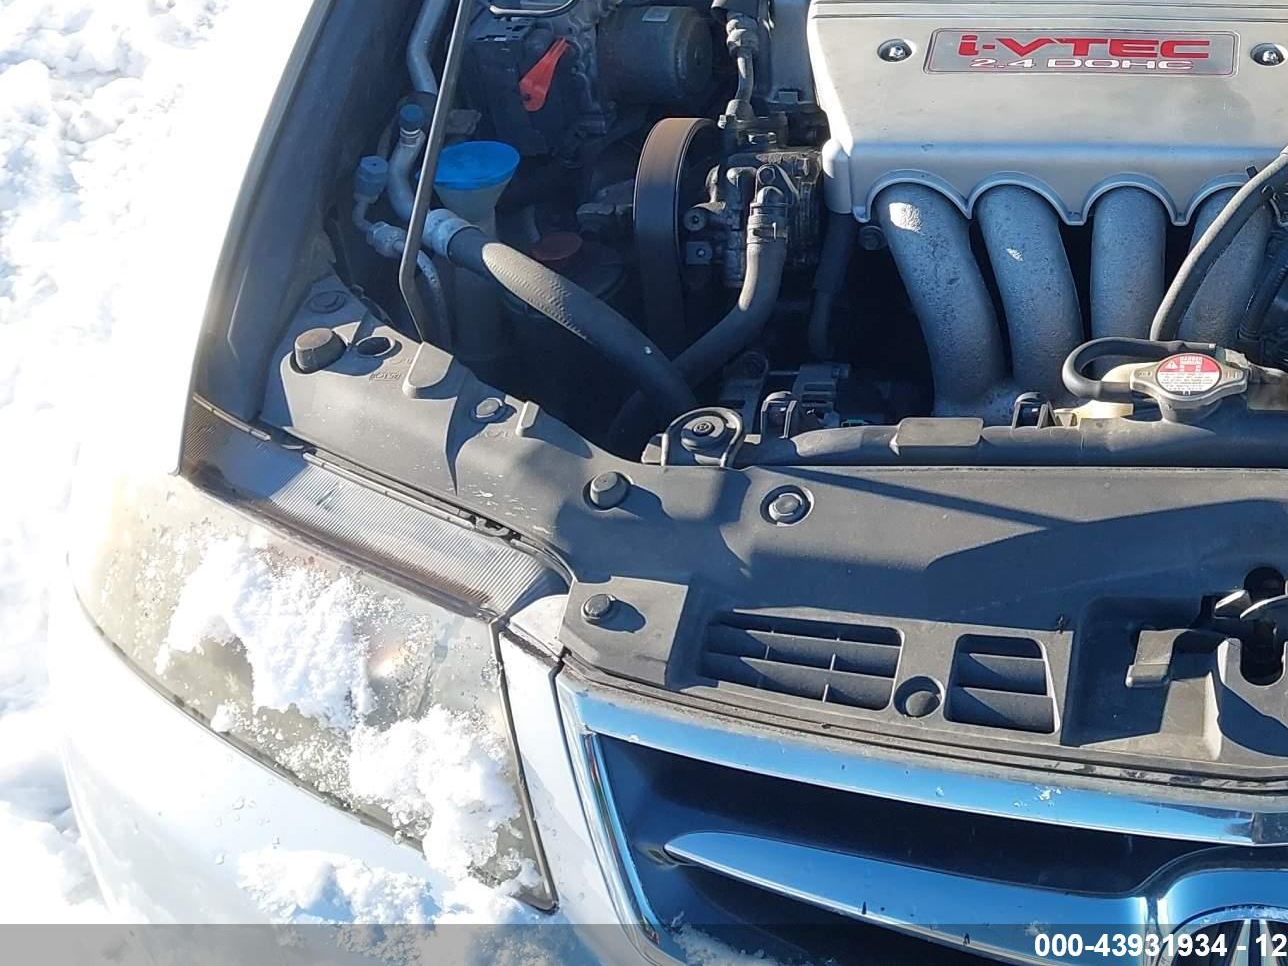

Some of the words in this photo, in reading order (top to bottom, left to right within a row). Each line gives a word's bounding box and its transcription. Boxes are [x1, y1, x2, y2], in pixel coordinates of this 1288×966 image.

[958, 34, 1211, 59] i-VTEC
[969, 57, 1036, 70] 2.4
[1046, 58, 1195, 71] DOHC
